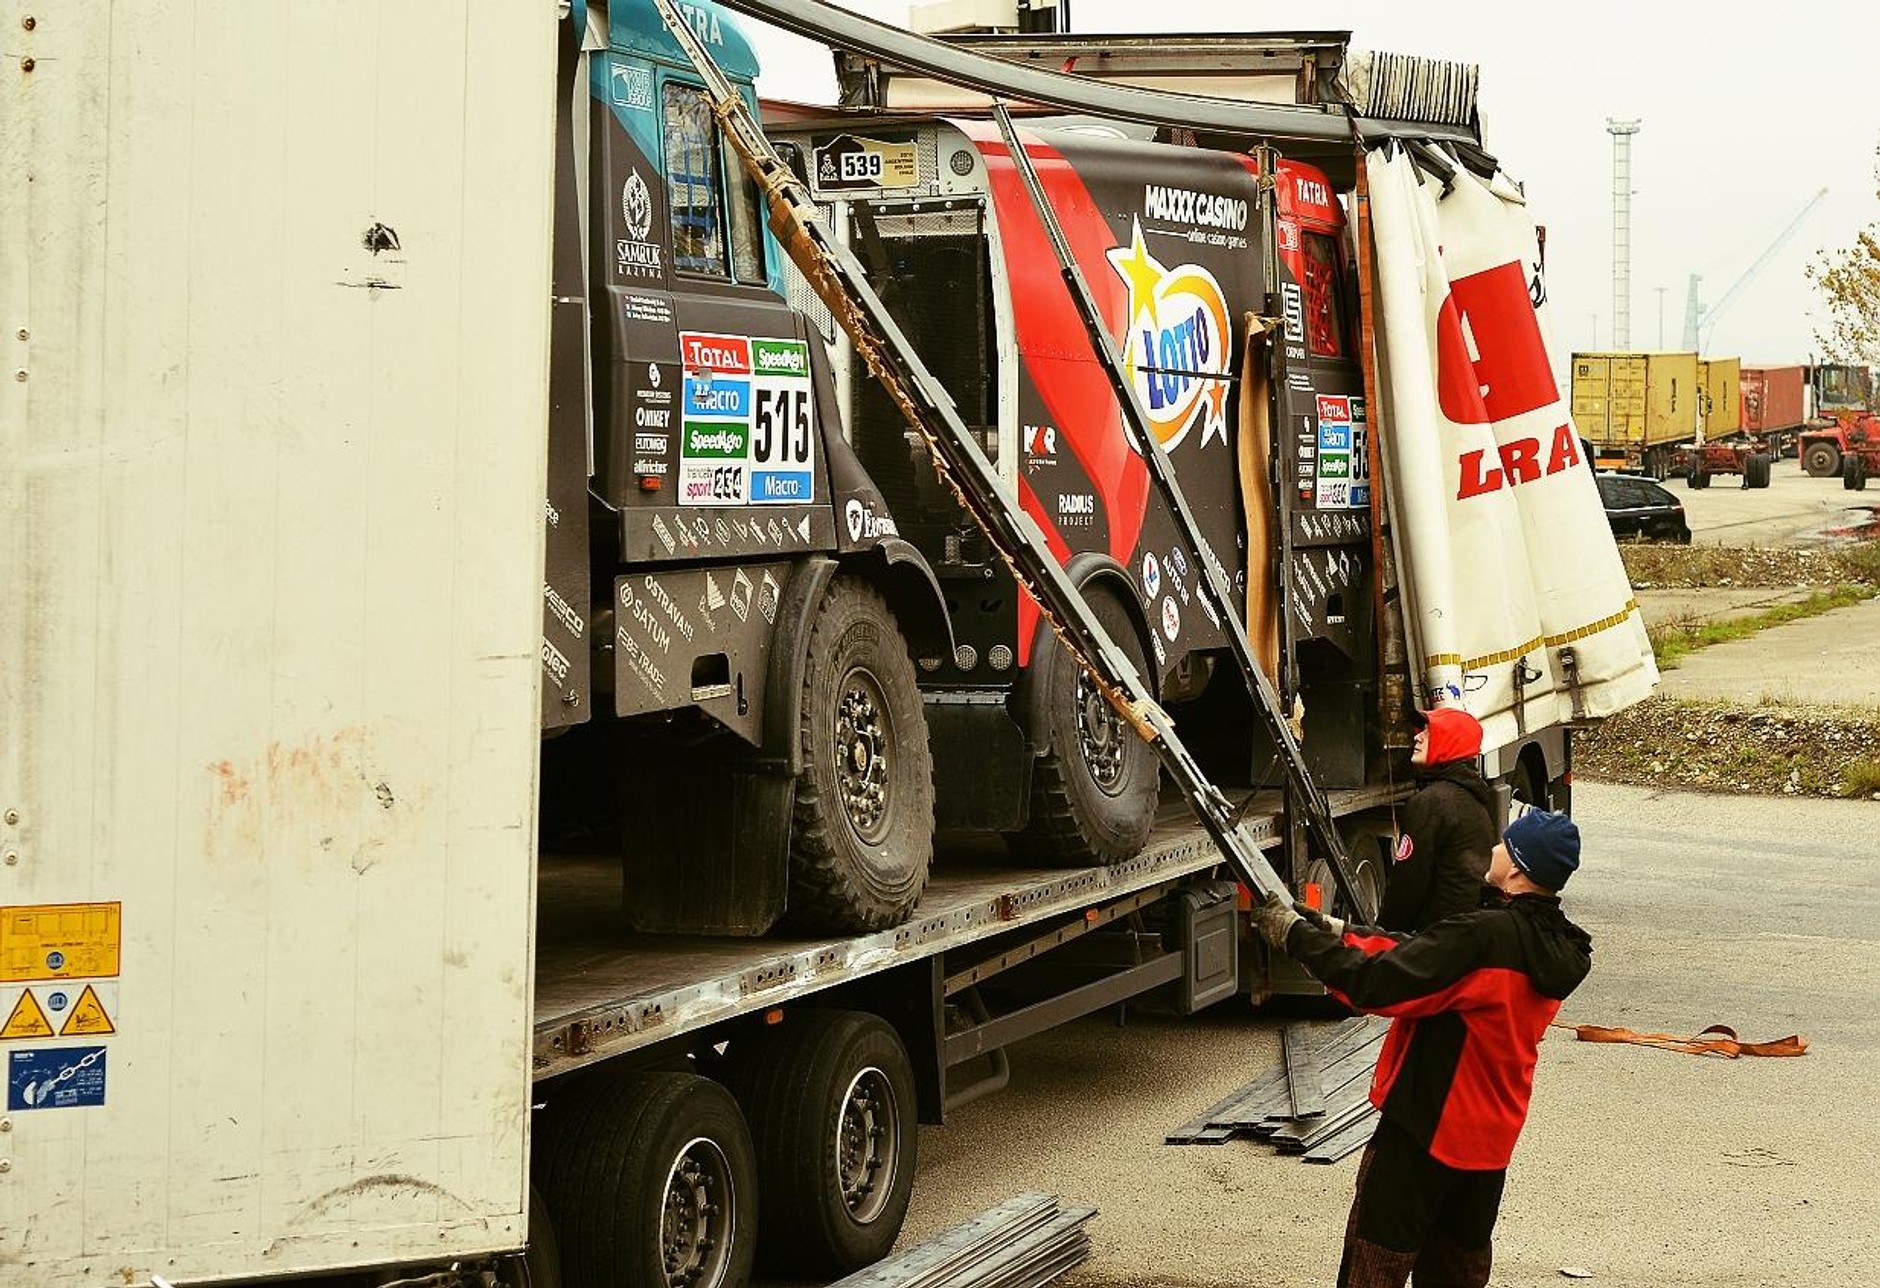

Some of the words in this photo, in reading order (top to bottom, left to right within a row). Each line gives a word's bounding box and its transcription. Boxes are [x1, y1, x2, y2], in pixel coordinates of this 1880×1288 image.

[845, 155, 881, 177] 539
[1296, 178, 1329, 207] TATRA
[1145, 184, 1197, 224] MAXXX
[1196, 193, 1248, 232] CASINO
[689, 341, 744, 369] TOTAL
[1142, 306, 1210, 410] LOTTO
[754, 389, 809, 463] 515
[689, 429, 743, 454] SpeedAgro
[764, 475, 800, 496] Macro
[1058, 494, 1094, 514] RADIUS
[632, 599, 671, 655] SATUM
